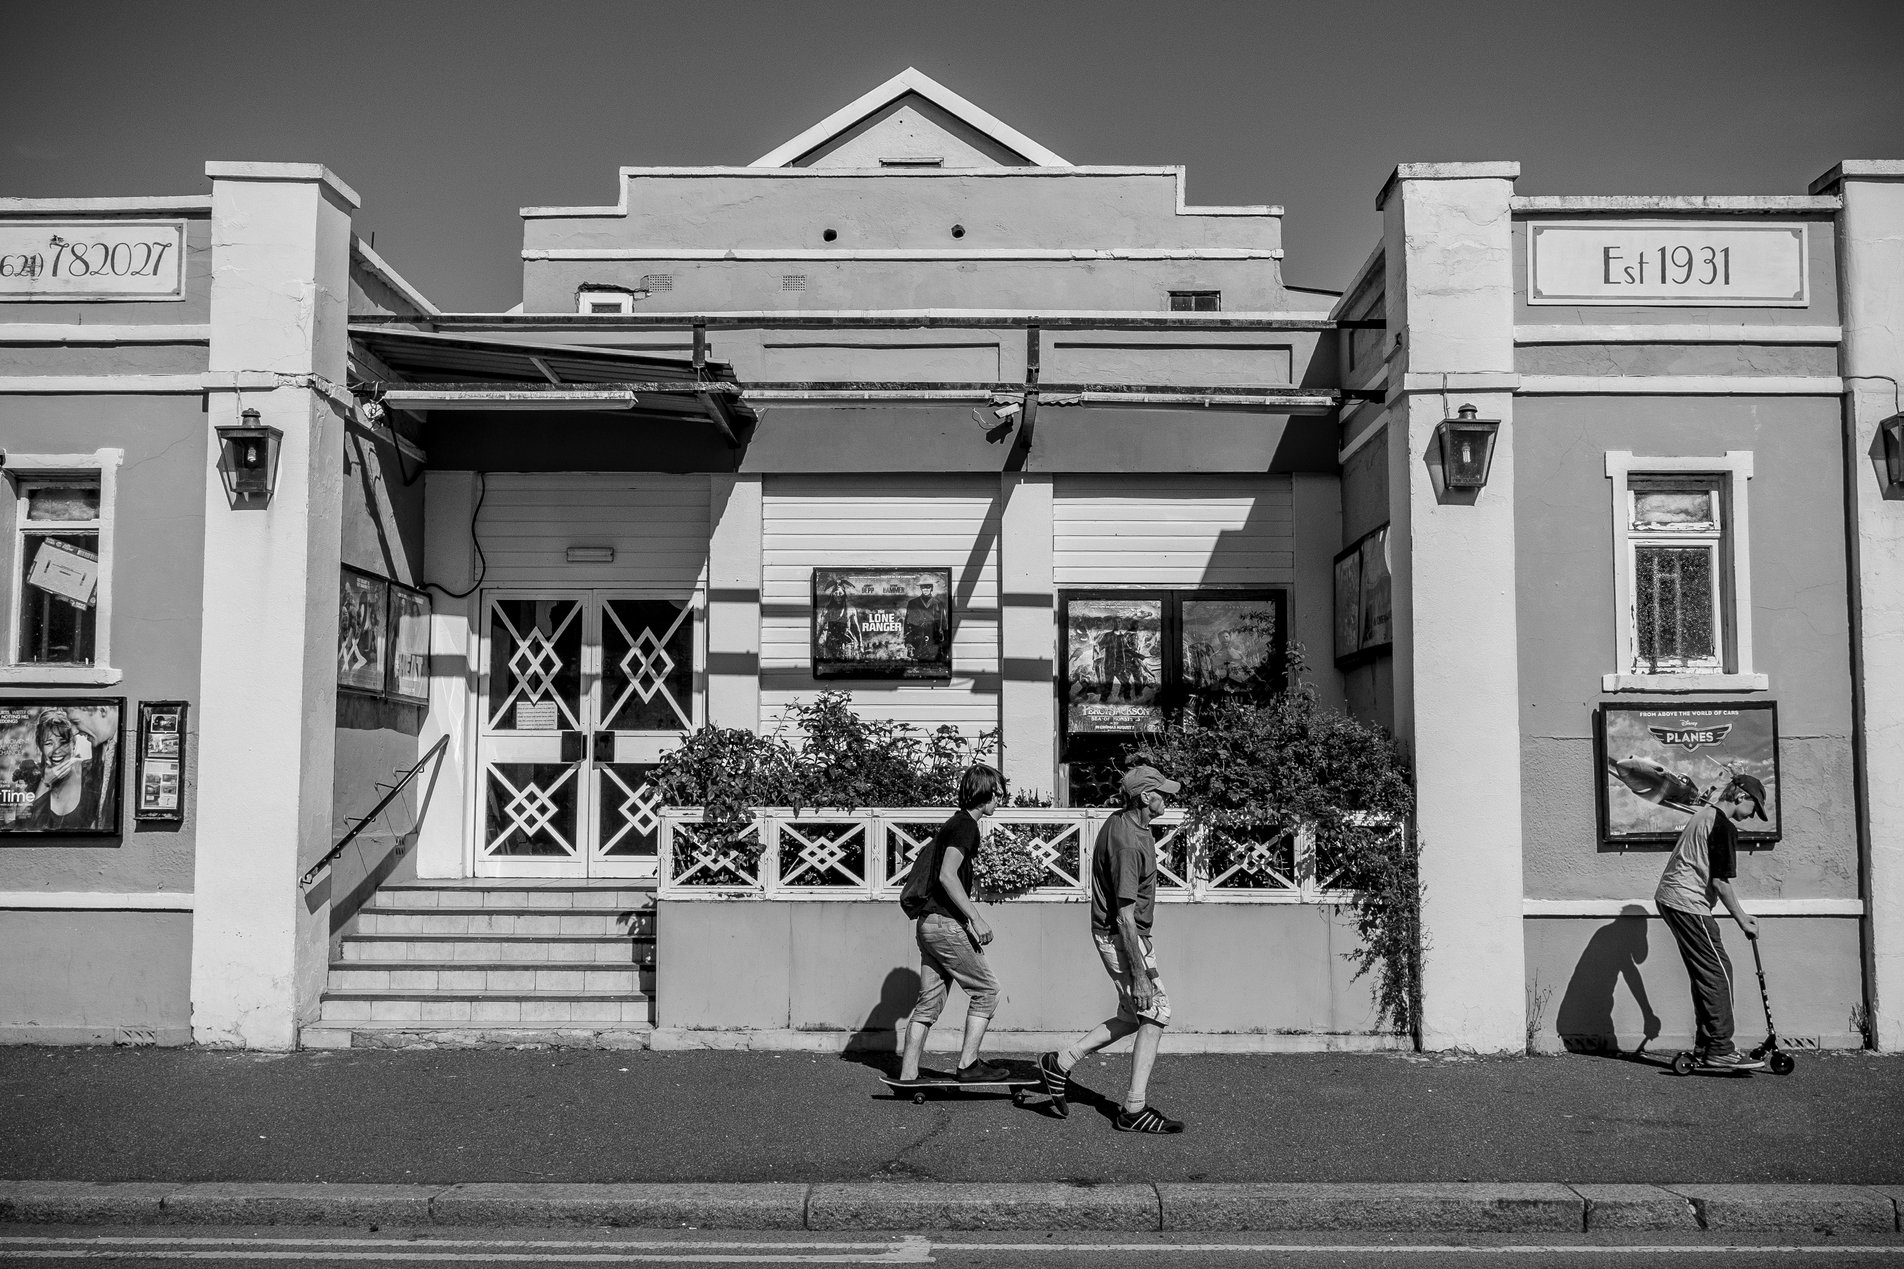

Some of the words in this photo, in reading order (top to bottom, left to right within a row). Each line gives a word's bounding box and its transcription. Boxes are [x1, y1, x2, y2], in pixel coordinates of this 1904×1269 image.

[49, 242, 173, 277] 782027
[1603, 246, 1649, 285] Est
[1657, 245, 1731, 286] 1931
[868, 613, 895, 623] LONE
[861, 622, 902, 632] RANGER
[1666, 731, 1714, 743] PLANES
